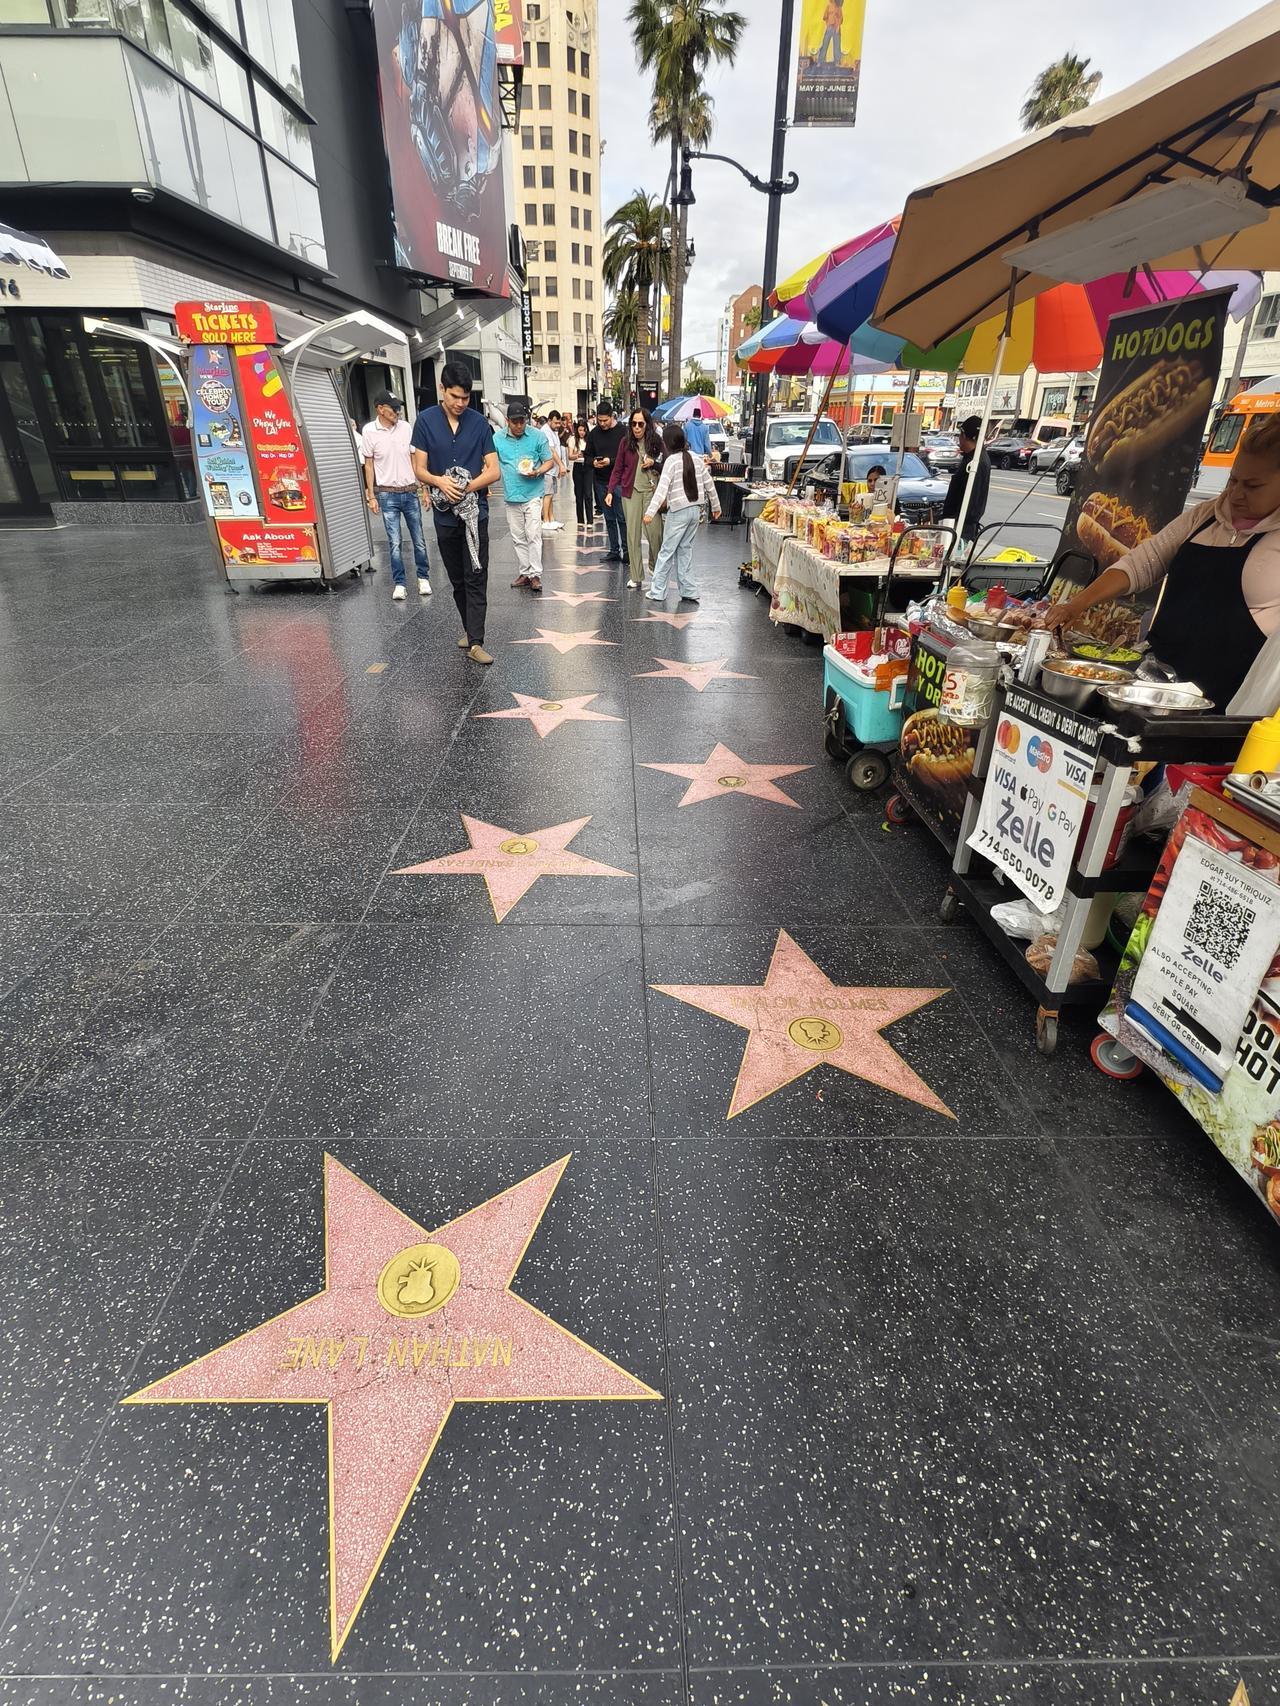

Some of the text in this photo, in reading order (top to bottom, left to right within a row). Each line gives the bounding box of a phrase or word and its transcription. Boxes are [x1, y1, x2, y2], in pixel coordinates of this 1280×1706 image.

[436, 221, 481, 266] BREAK FREE
[192, 313, 258, 331] TICKETS
[202, 332, 256, 343] SOLD HERE
[522, 294, 532, 352] Foot Locker
[1112, 315, 1216, 361] HOTDOGS
[649, 350, 658, 361] M
[196, 387, 232, 396] CELEBRITY
[1255, 400, 1275, 408] Metro
[253, 418, 291, 429] Show You
[264, 410, 276, 419] We
[874, 489, 888, 501] IPS
[917, 648, 945, 684] HOT
[918, 674, 942, 707] Y DR
[1005, 692, 1098, 748] WE ACCEPT ALL CREDIT & DEBIT CARDS
[994, 765, 1017, 795] VISA
[1065, 761, 1087, 786] VISA
[1027, 788, 1044, 816] Pay
[996, 796, 1055, 868] Zelle
[1058, 811, 1077, 838] Pay
[979, 830, 1055, 900] 714-650-0078
[1201, 858, 1272, 905] EDGAR SUY TIRIQUIZ
[1151, 946, 1215, 997] ALSO ACCEPTING:
[1180, 944, 1224, 984] Zelle
[1160, 966, 1199, 999] APPLE PAY
[809, 997, 890, 1011] HOLMES
[1171, 989, 1199, 1017] SQUARE
[1152, 1001, 1207, 1055] DEBIT OR CREDIT
[280, 1336, 514, 1369] NATHAN LANE
